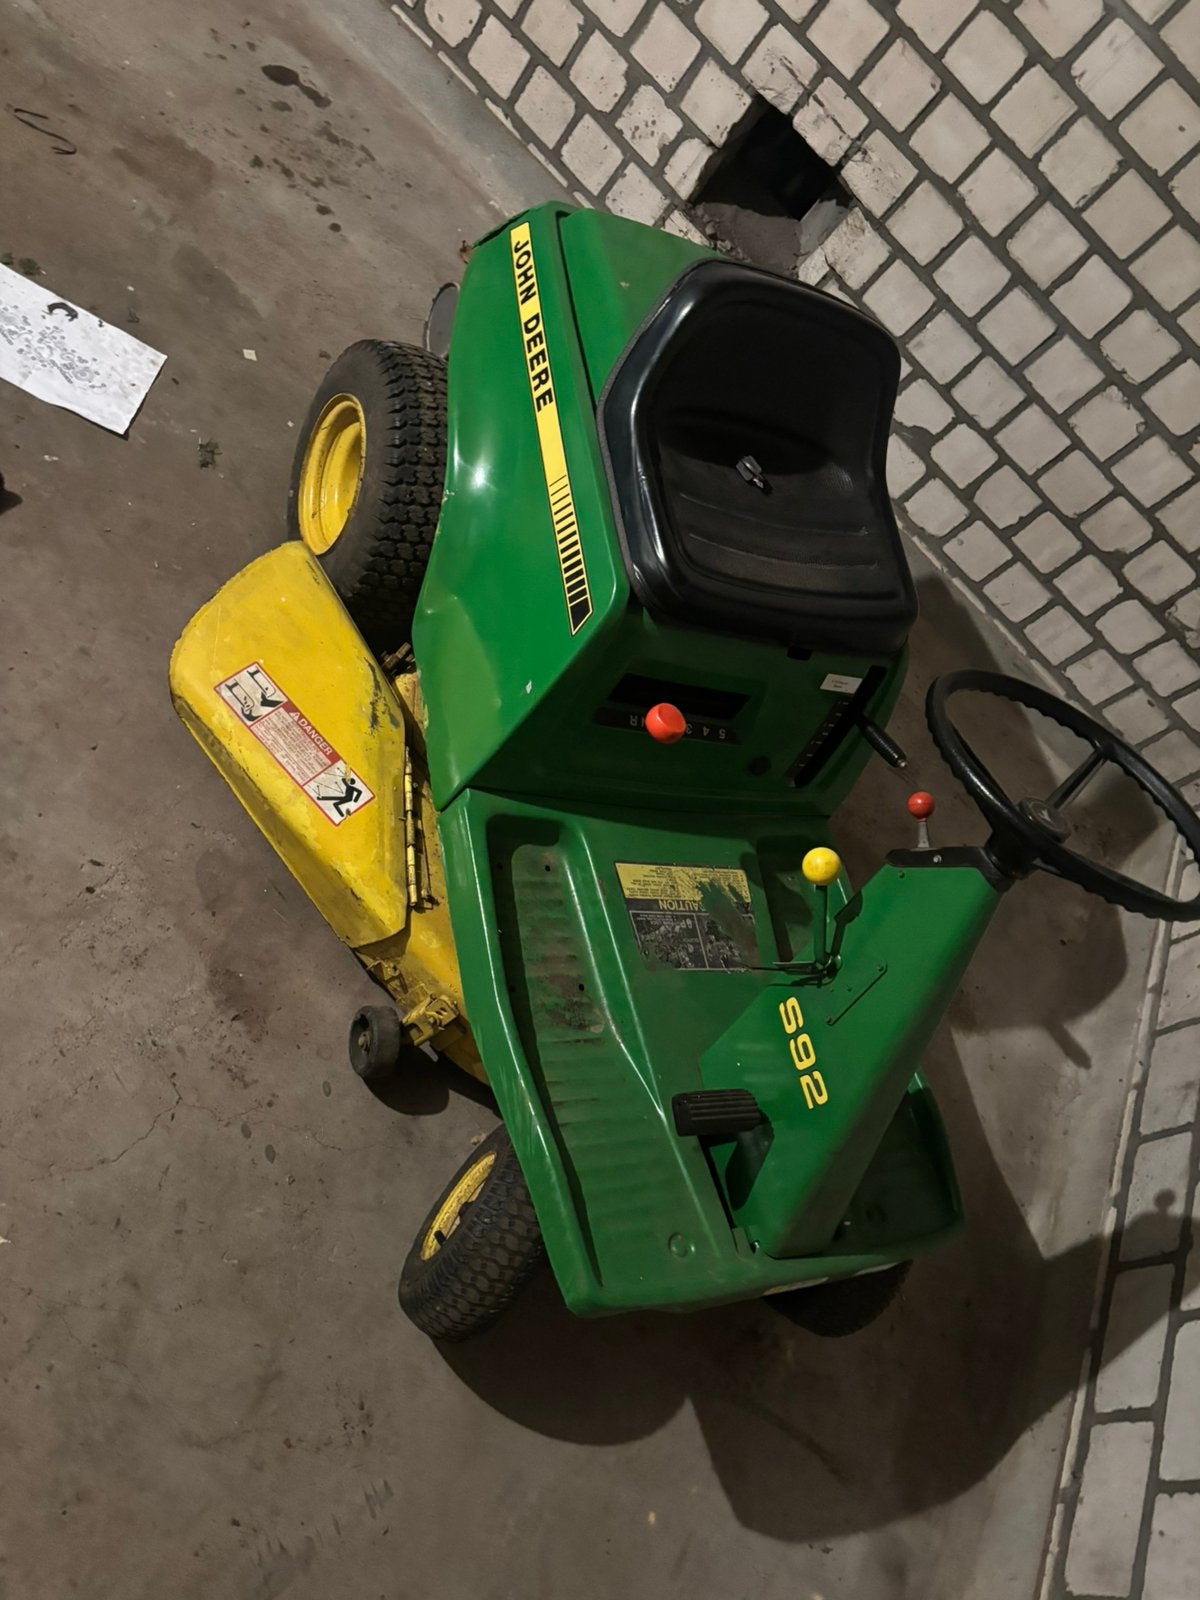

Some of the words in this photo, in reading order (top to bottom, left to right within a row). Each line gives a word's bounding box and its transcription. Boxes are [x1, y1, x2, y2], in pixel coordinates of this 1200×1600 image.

[514, 241, 536, 304] JOHN
[524, 313, 554, 412] DEERE
[298, 718, 333, 755] DANGER
[630, 715, 638, 726] R
[702, 726, 710, 736] 4
[719, 729, 727, 739] 5
[779, 996, 828, 1110] S92
